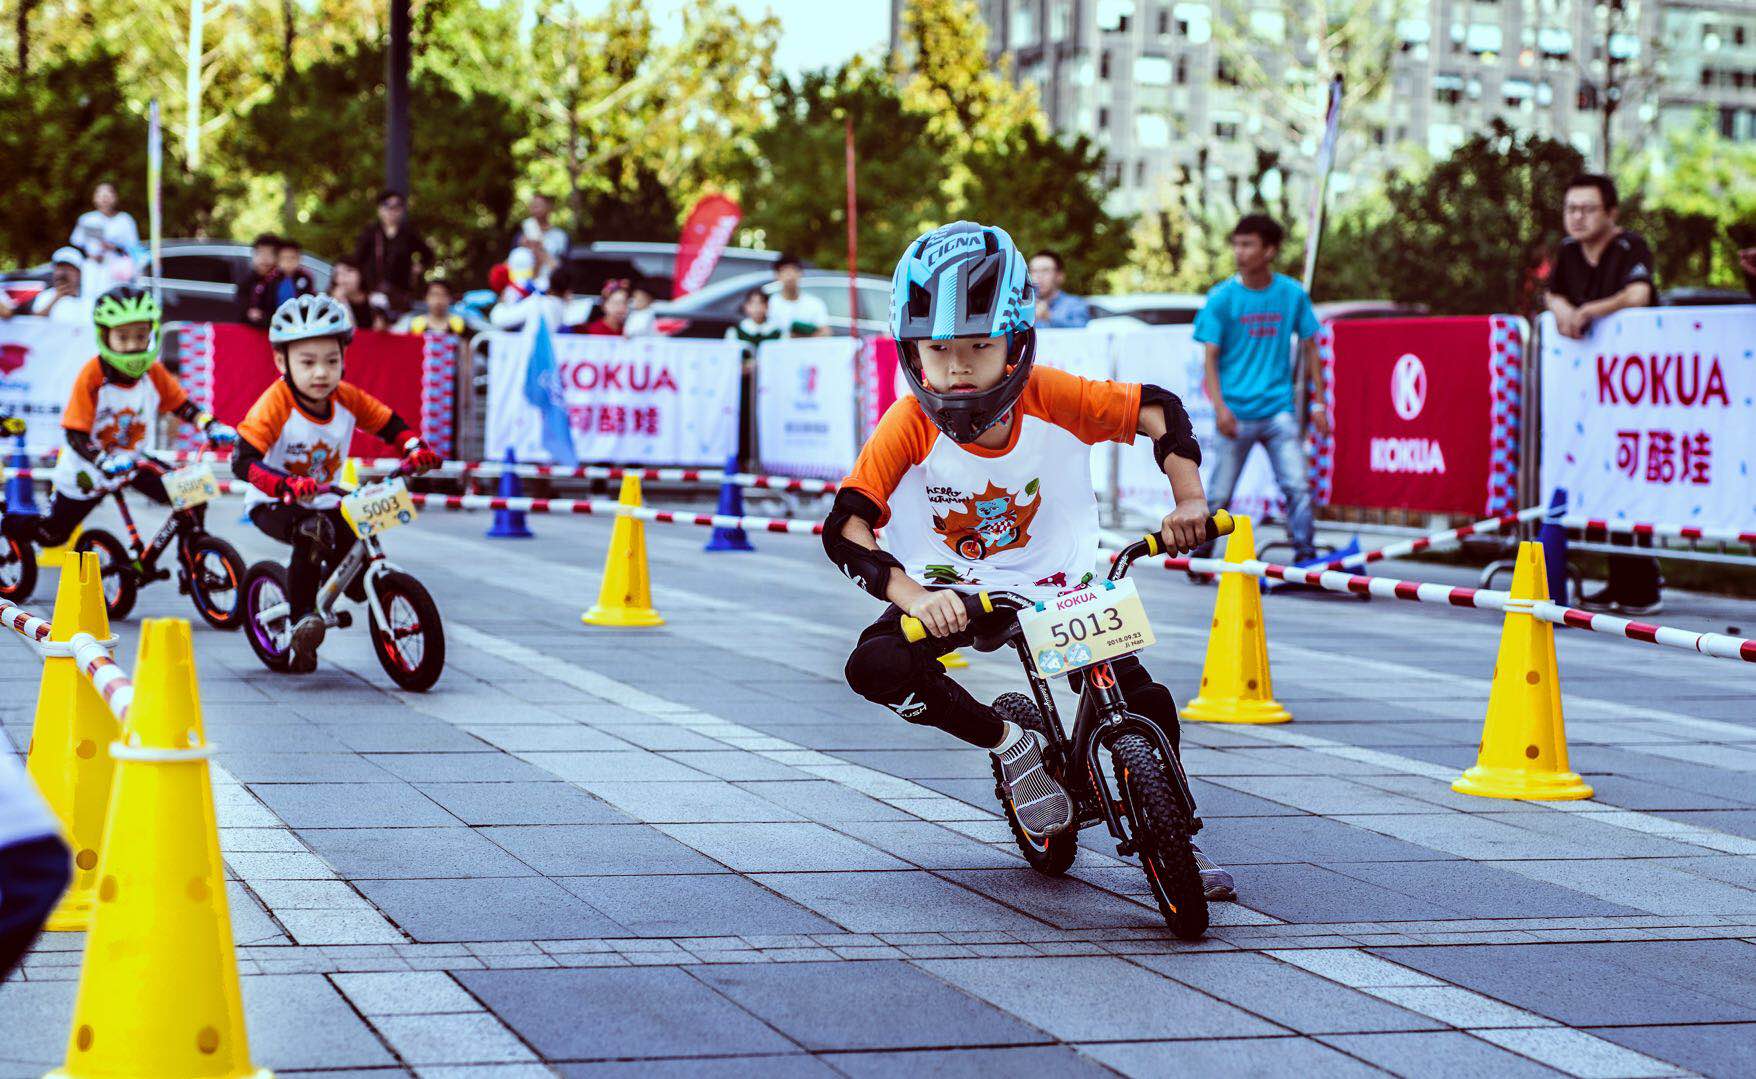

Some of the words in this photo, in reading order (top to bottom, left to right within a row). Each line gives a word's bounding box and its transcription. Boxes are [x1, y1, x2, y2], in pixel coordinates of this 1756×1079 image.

[928, 236, 981, 267] CIGNA
[1597, 354, 1729, 407] KOKUA
[1370, 438, 1446, 474] KOKUA
[1616, 430, 1711, 484] 可酷娃
[362, 495, 399, 518] 5003
[926, 486, 961, 496] hello
[1057, 592, 1097, 610] KOKUA
[1051, 607, 1123, 647] 5013
[1107, 632, 1142, 646] 2018.09.23
